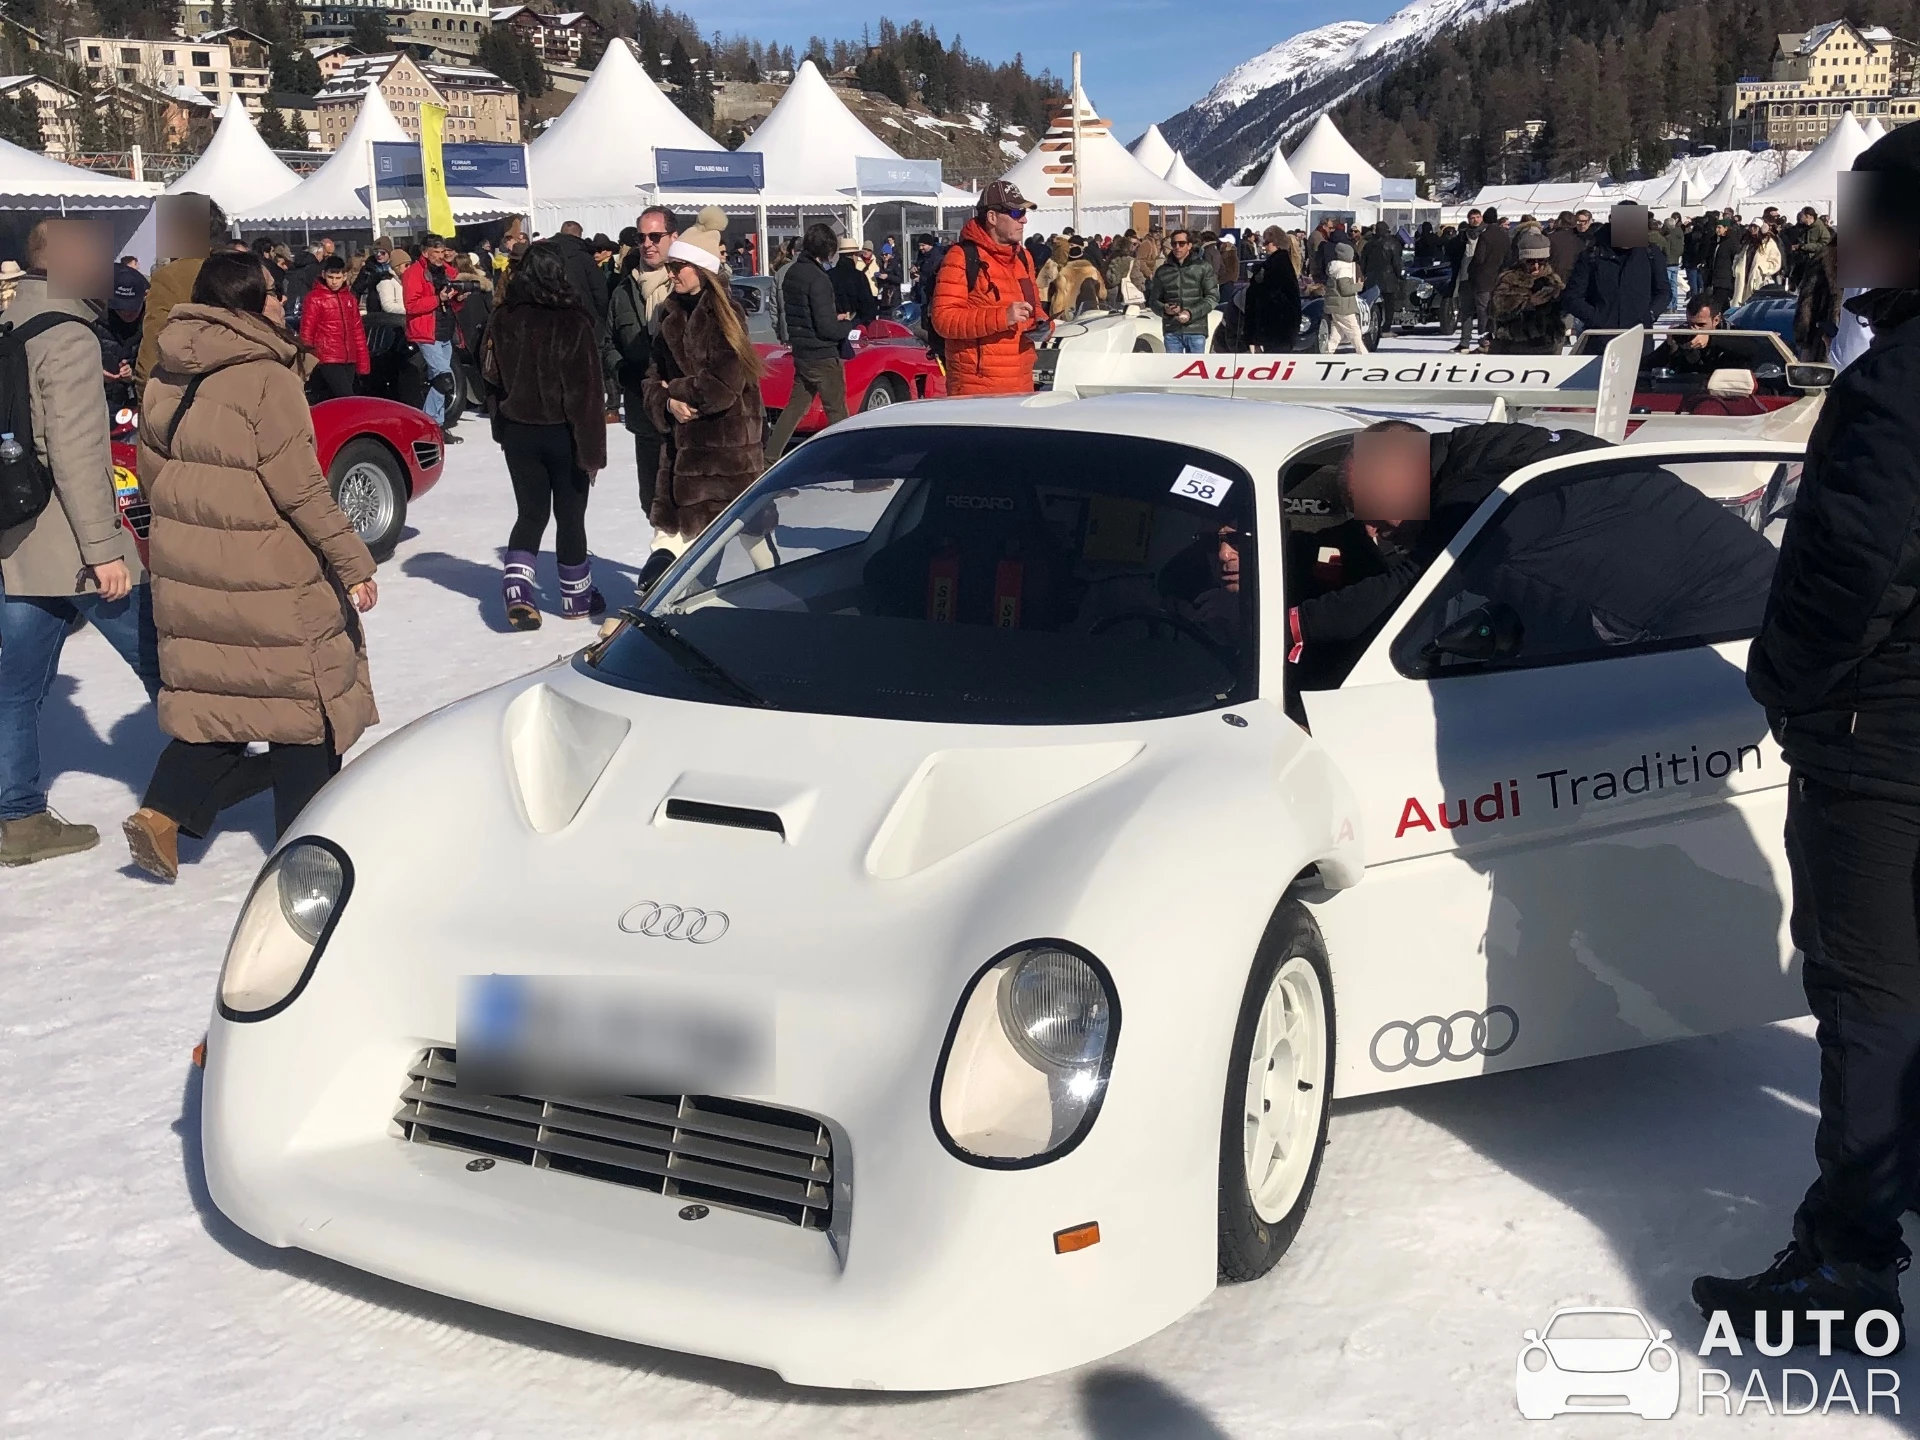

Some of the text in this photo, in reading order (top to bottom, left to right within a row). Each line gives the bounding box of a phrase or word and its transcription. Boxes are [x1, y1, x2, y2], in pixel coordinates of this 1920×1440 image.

[887, 171, 911, 179] THE ICE
[1172, 360, 1551, 384] Audi Tradition
[1182, 480, 1215, 499] 58
[946, 495, 1014, 510] RECARO
[1394, 743, 1762, 838] Audi Tradition
